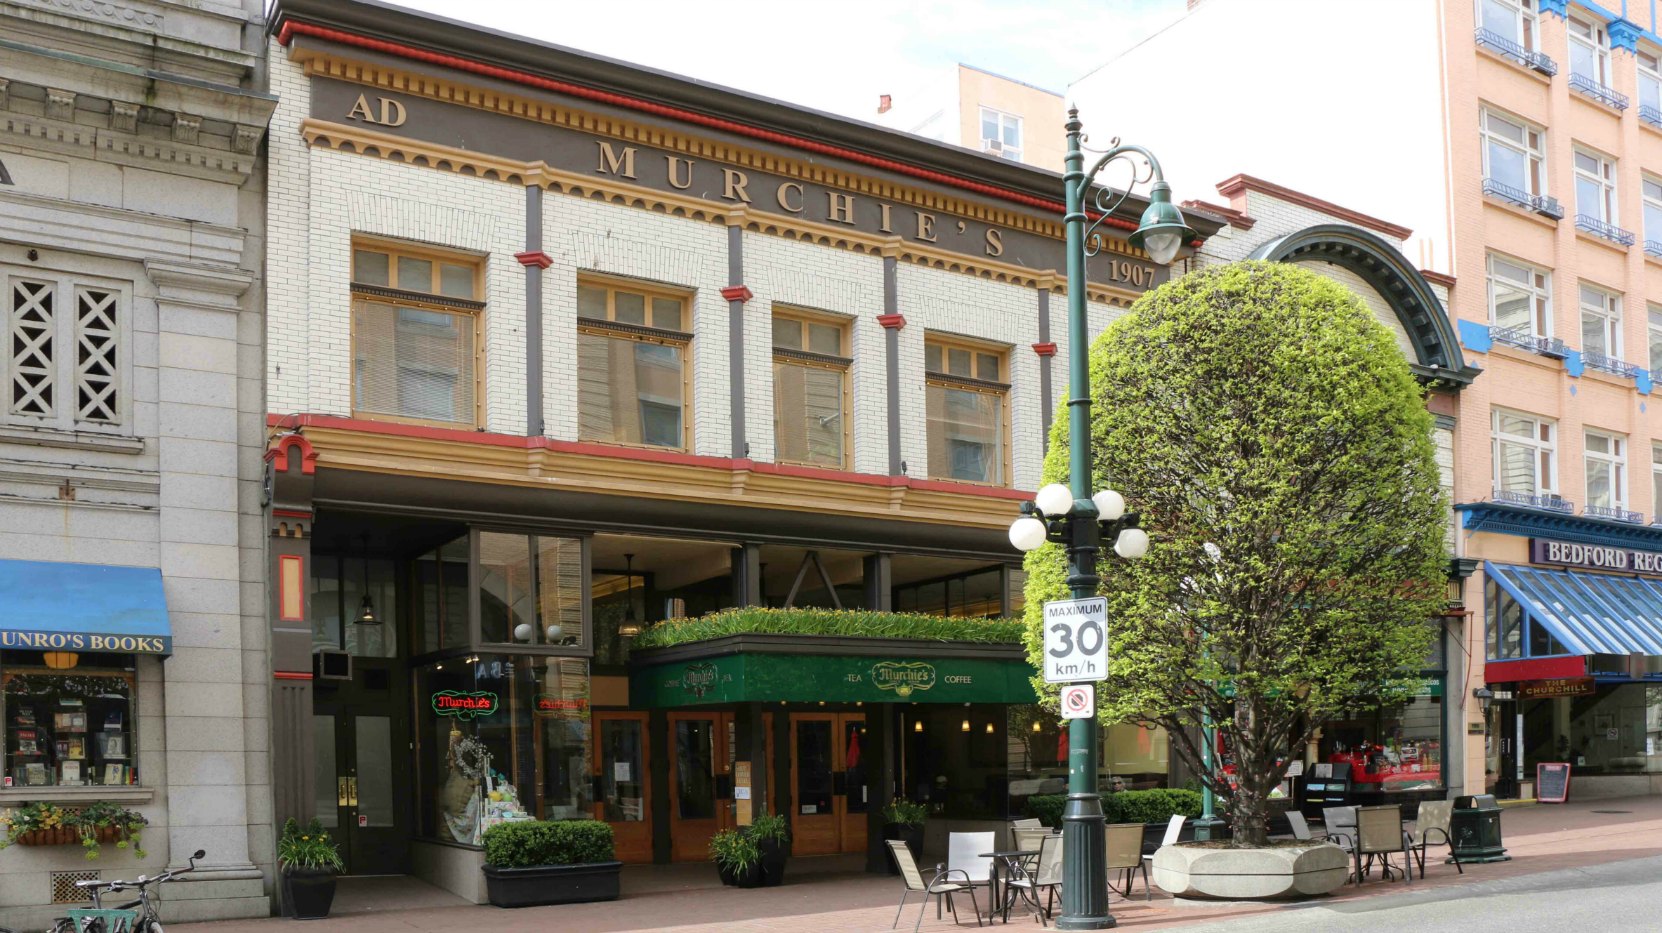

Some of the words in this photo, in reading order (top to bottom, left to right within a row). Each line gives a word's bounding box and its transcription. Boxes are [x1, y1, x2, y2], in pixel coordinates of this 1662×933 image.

[346, 93, 407, 127] AD
[596, 140, 1003, 257] MURCHIE'S
[1109, 260, 1156, 288] 1907
[1548, 542, 1627, 568] BEDFORD
[1049, 604, 1102, 617] MAXIMUM
[89, 635, 164, 652] BOOKS
[1049, 620, 1104, 658] 30
[1056, 659, 1096, 675] km/h
[848, 674, 862, 682] TEA
[879, 668, 928, 681] Murchie's
[944, 675, 972, 684] COFFEE
[1526, 685, 1588, 695] CHURCHILL
[1545, 679, 1566, 687] THE
